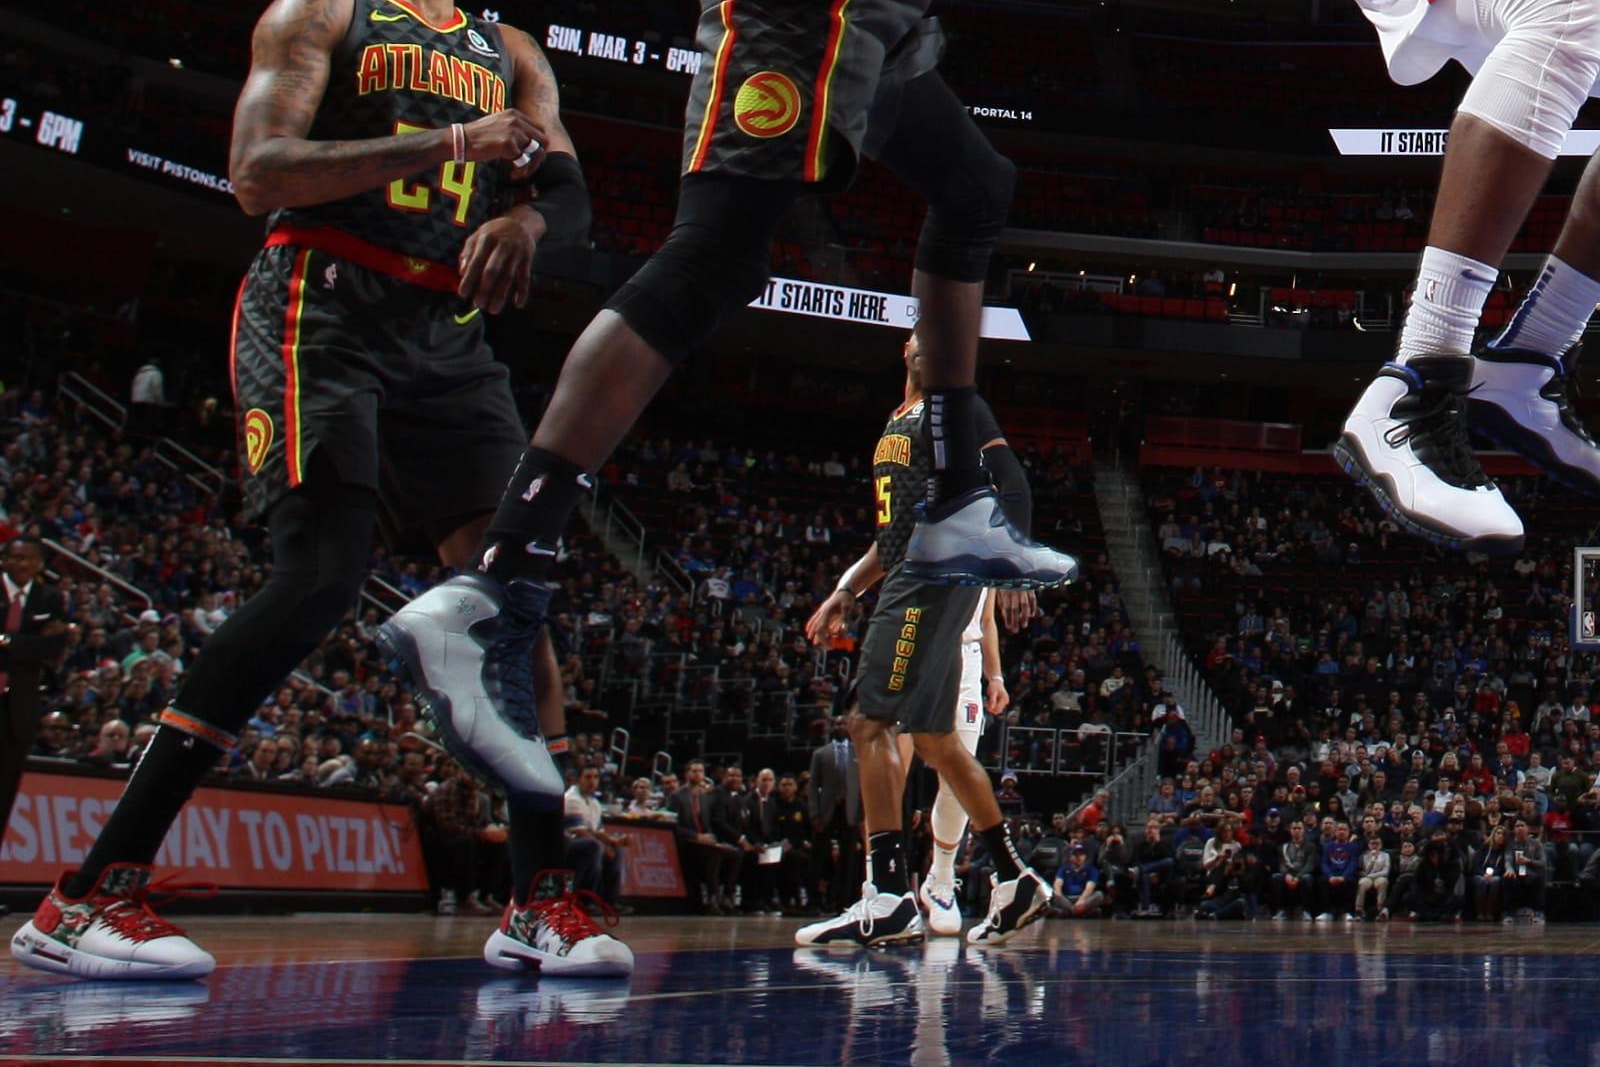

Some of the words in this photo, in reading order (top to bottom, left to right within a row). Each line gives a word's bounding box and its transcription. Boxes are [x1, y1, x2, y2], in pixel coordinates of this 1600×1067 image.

[547, 24, 583, 56] SUN,
[587, 32, 628, 62] MAR.
[633, 42, 645, 65] 3
[666, 47, 702, 75] 6PM
[357, 43, 505, 114] ATLANTA
[0, 98, 16, 132] 3
[37, 111, 83, 154] 6PM
[973, 106, 1017, 119] PORTAL
[1020, 110, 1032, 121] 14
[1381, 132, 1394, 153] IT
[128, 148, 162, 170] VISIT
[162, 160, 234, 194] PISTONS.CO
[760, 281, 776, 306] IT
[781, 284, 844, 316] STARTS
[849, 293, 889, 323] HERE.
[888, 607, 921, 691] HAWKS
[239, 810, 292, 872] TO
[300, 814, 406, 876] PIZZA!
